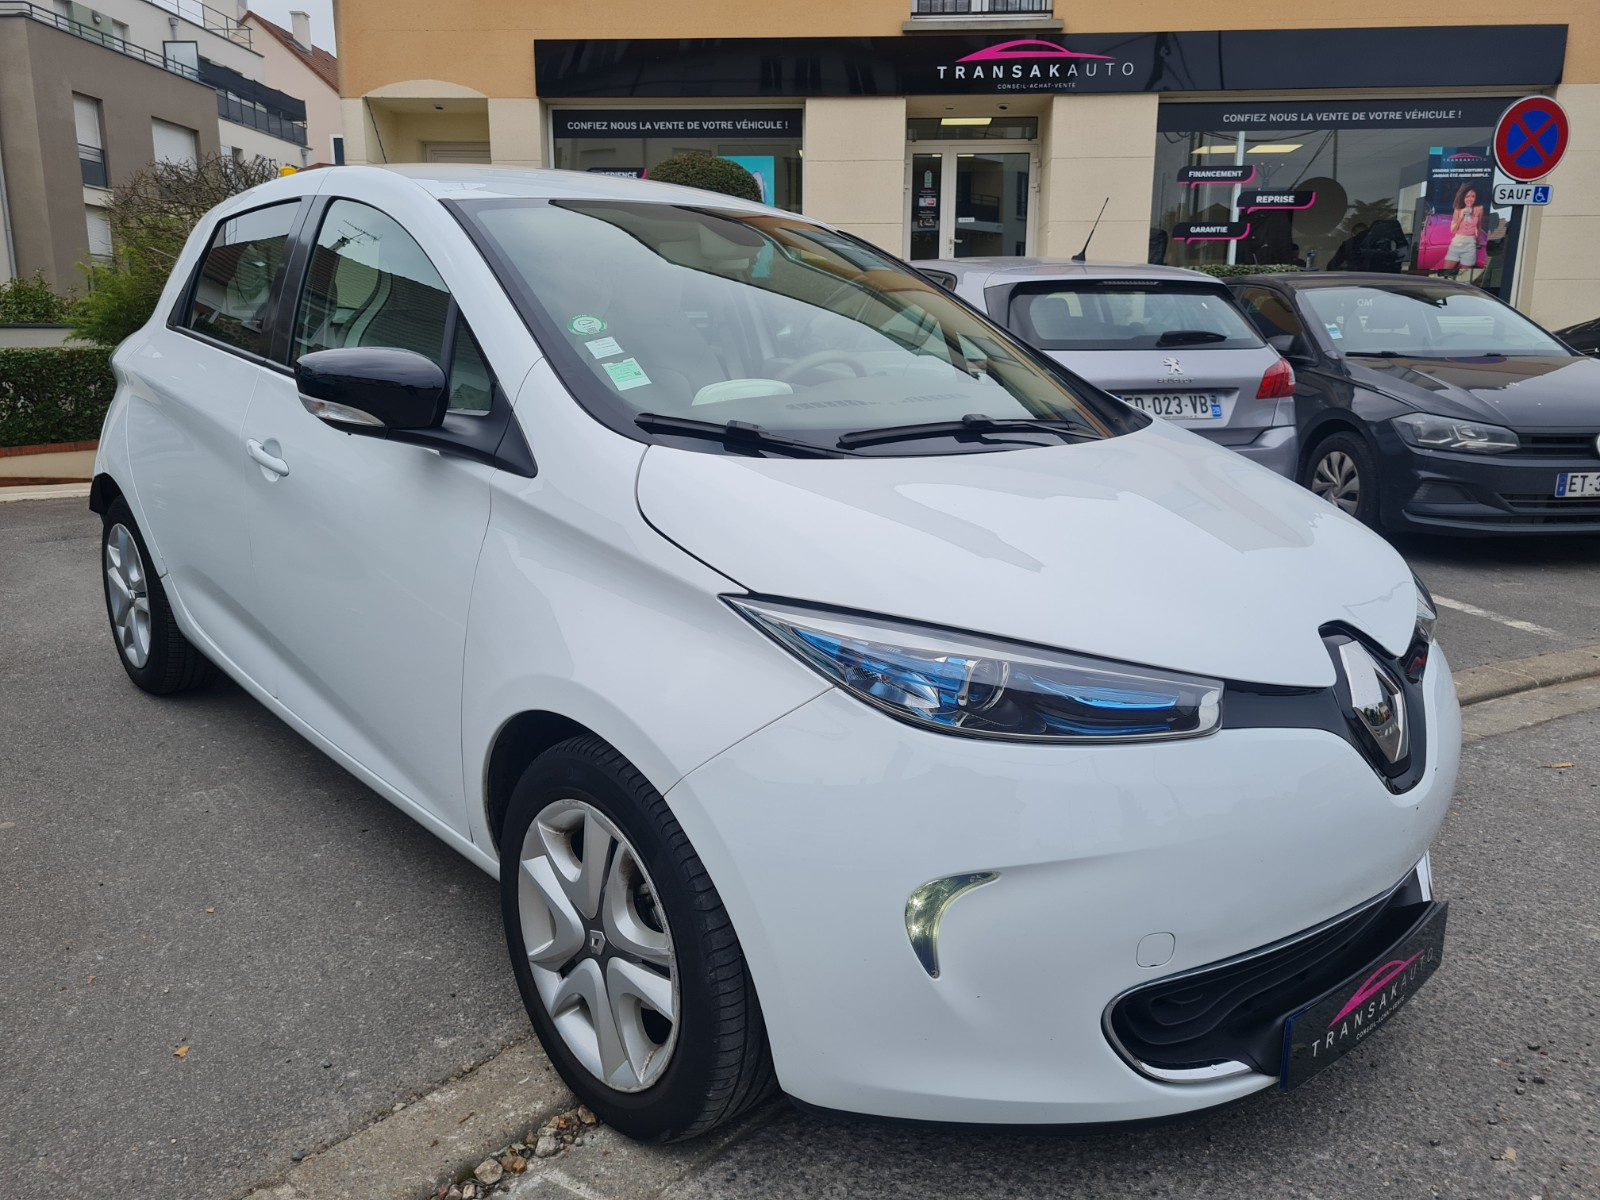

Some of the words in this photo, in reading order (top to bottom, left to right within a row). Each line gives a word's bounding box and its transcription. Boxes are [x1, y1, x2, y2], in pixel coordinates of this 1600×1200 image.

[936, 62, 1135, 79] TRANSAKAUTO
[1222, 113, 1267, 123] CONFIEZ
[1269, 113, 1298, 122] NOUS
[1300, 112, 1314, 121] LA
[1316, 112, 1349, 121] VENTE
[1352, 111, 1366, 120] DE
[1368, 111, 1402, 120] VOTRE
[1405, 108, 1456, 119] VÉHICULE
[567, 121, 608, 130] CONFIEZ
[610, 121, 637, 130] NOUS
[639, 121, 652, 130] LA
[653, 121, 685, 130] VENTE
[687, 121, 700, 130] DE
[702, 120, 734, 129] VOTRE
[736, 118, 783, 129] VÉHICULE
[1188, 170, 1243, 178] FINANCEMENT
[1255, 195, 1295, 203] REPRISE
[1499, 188, 1532, 200] SAUF
[1123, 395, 1209, 415] D-023-VB
[1311, 947, 1434, 1057] TRANSAKAUTO
